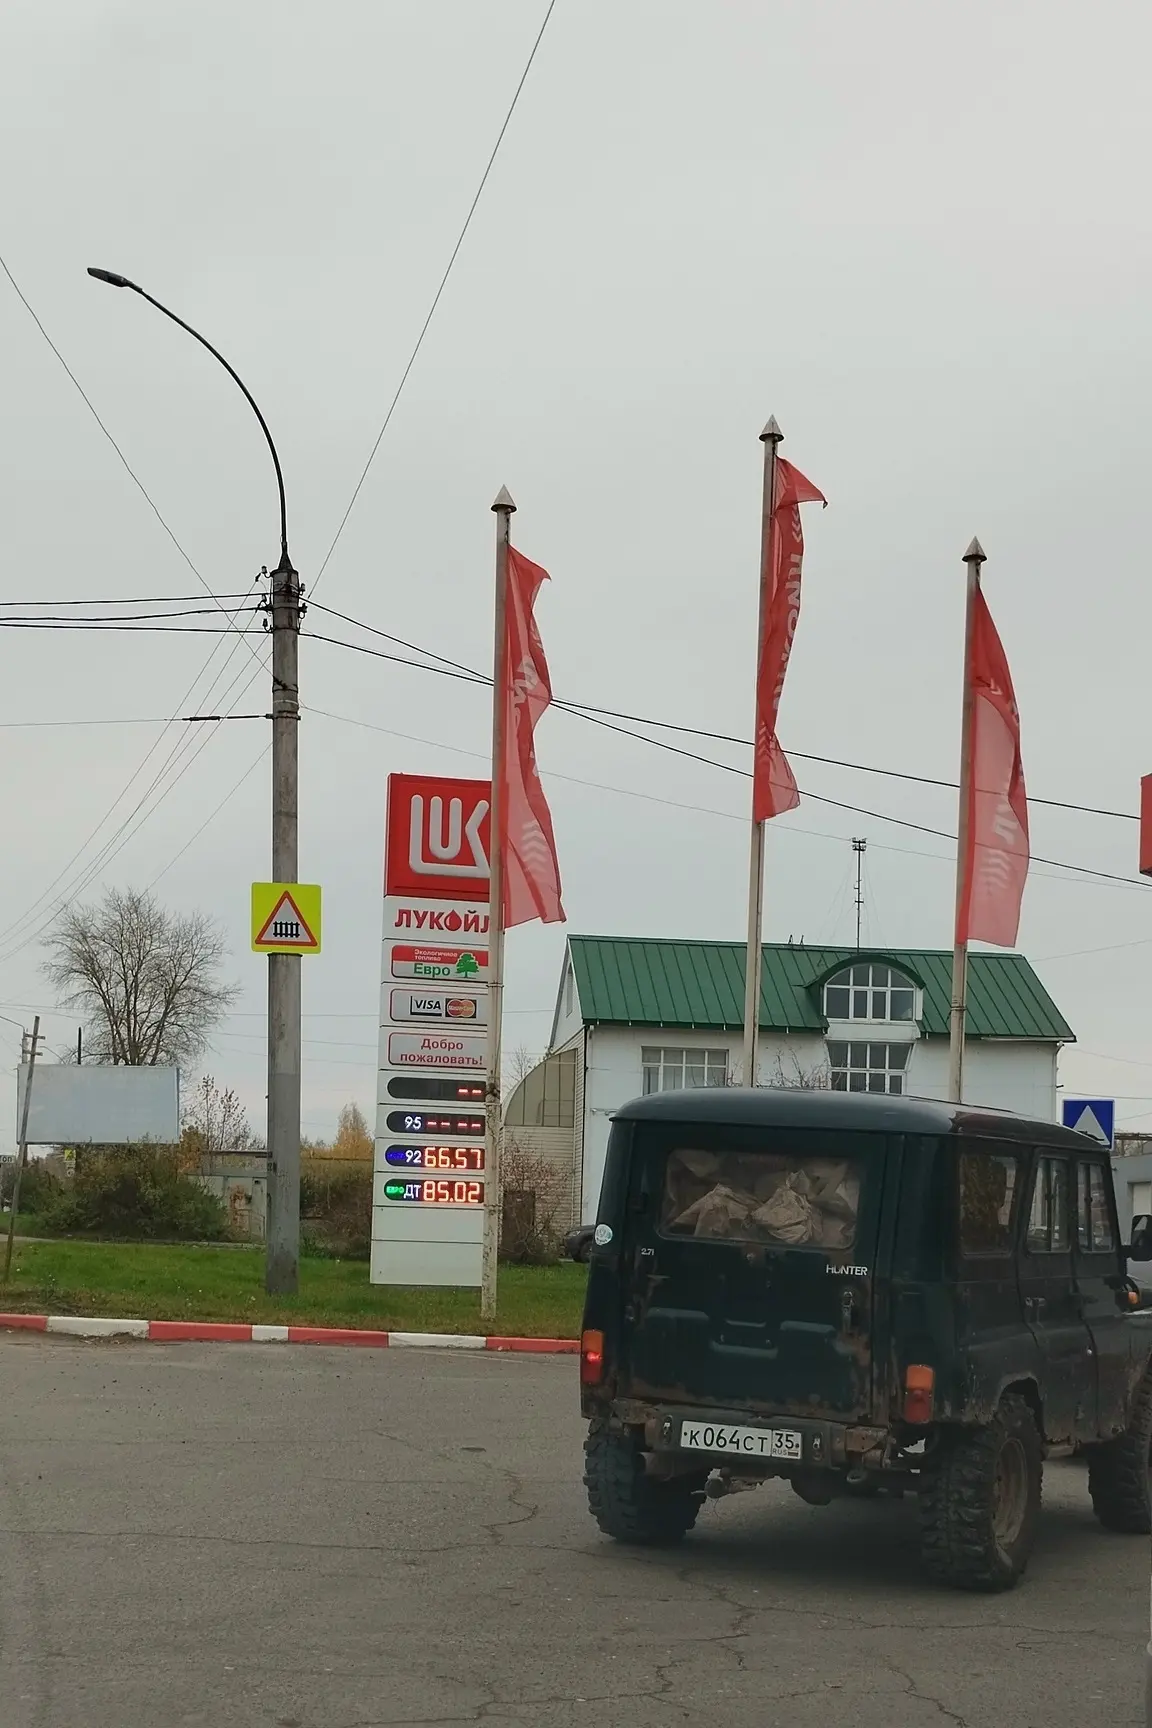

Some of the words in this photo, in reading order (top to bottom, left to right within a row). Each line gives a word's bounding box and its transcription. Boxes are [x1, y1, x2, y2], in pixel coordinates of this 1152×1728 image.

[413, 963, 451, 978] Евро
[414, 999, 442, 1010] VISA
[421, 1038, 464, 1051] Добро
[400, 1053, 483, 1065] пожаловать!
[404, 1116, 422, 1129] 95
[405, 1150, 422, 1163] 92
[424, 1147, 481, 1169] 66.57
[403, 1184, 422, 1199] ДТ
[423, 1180, 480, 1203] 85.02
[825, 1264, 868, 1276] HUNTER
[774, 1432, 795, 1449] 35
